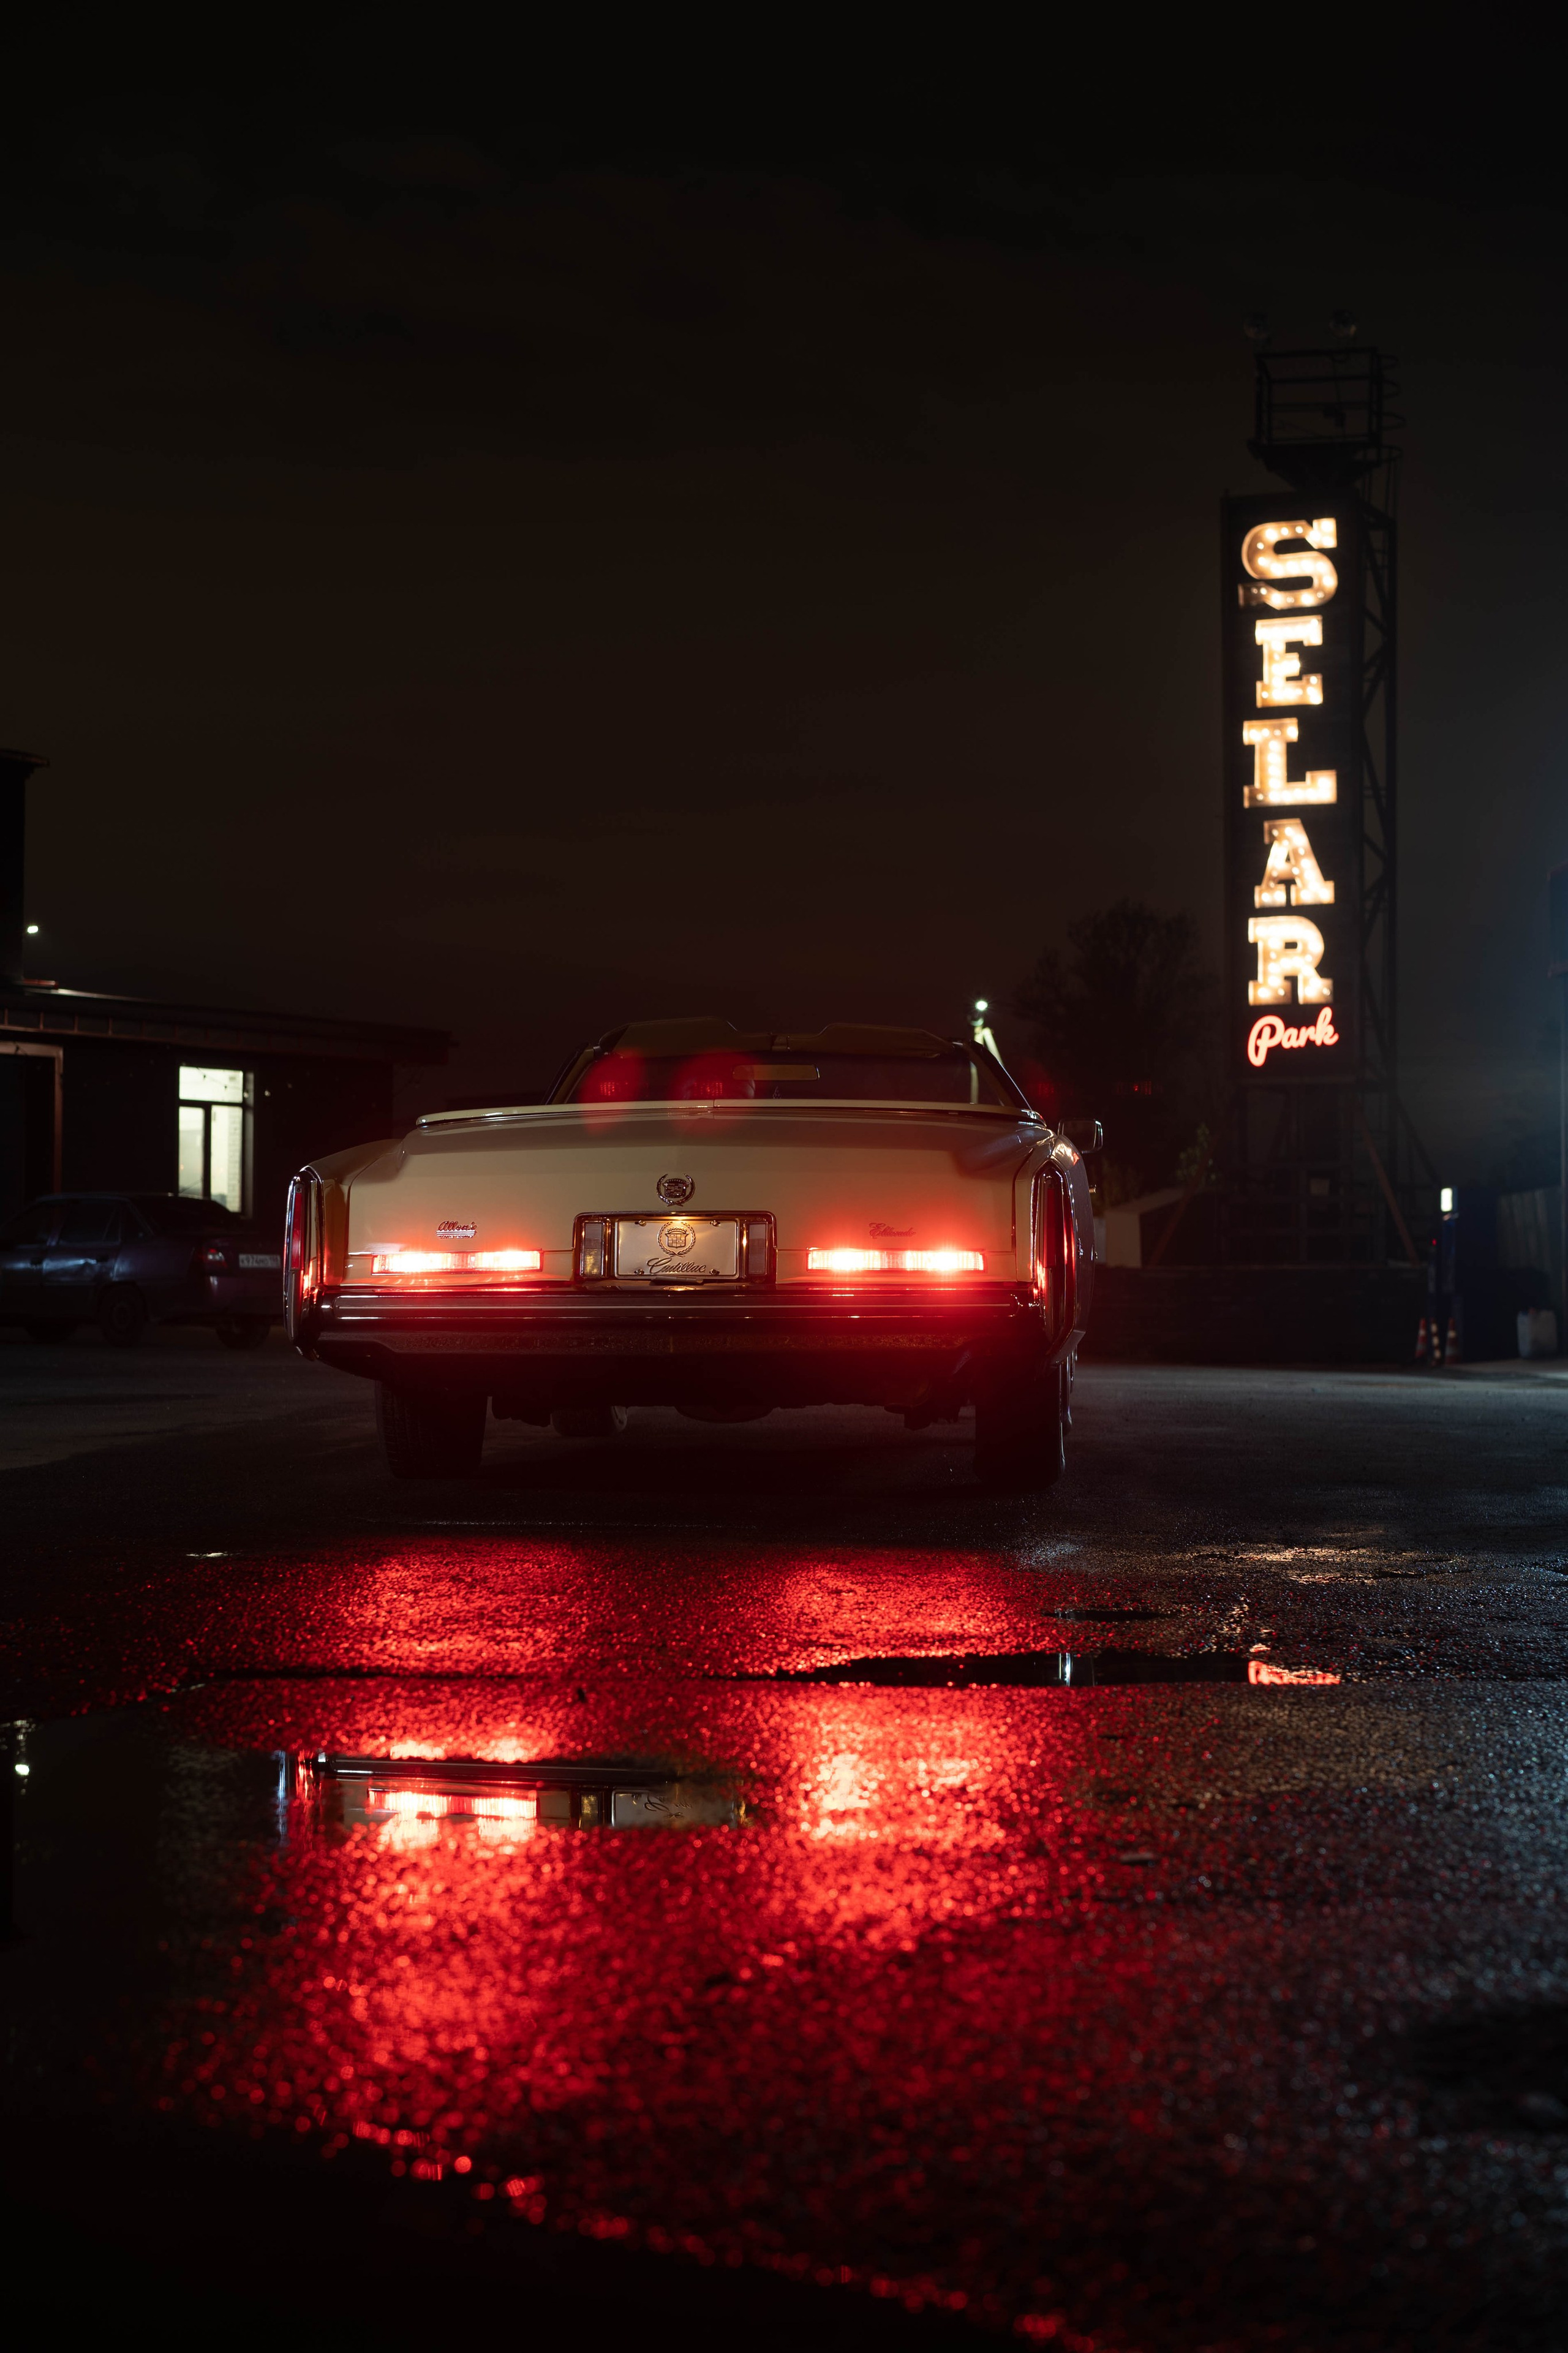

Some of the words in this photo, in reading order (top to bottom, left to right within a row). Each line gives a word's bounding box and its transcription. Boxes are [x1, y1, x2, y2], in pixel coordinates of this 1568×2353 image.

[1239, 518, 1338, 1006] SELAR
[1248, 1007, 1339, 1067] Park
[646, 1257, 707, 1274] Cadillac
